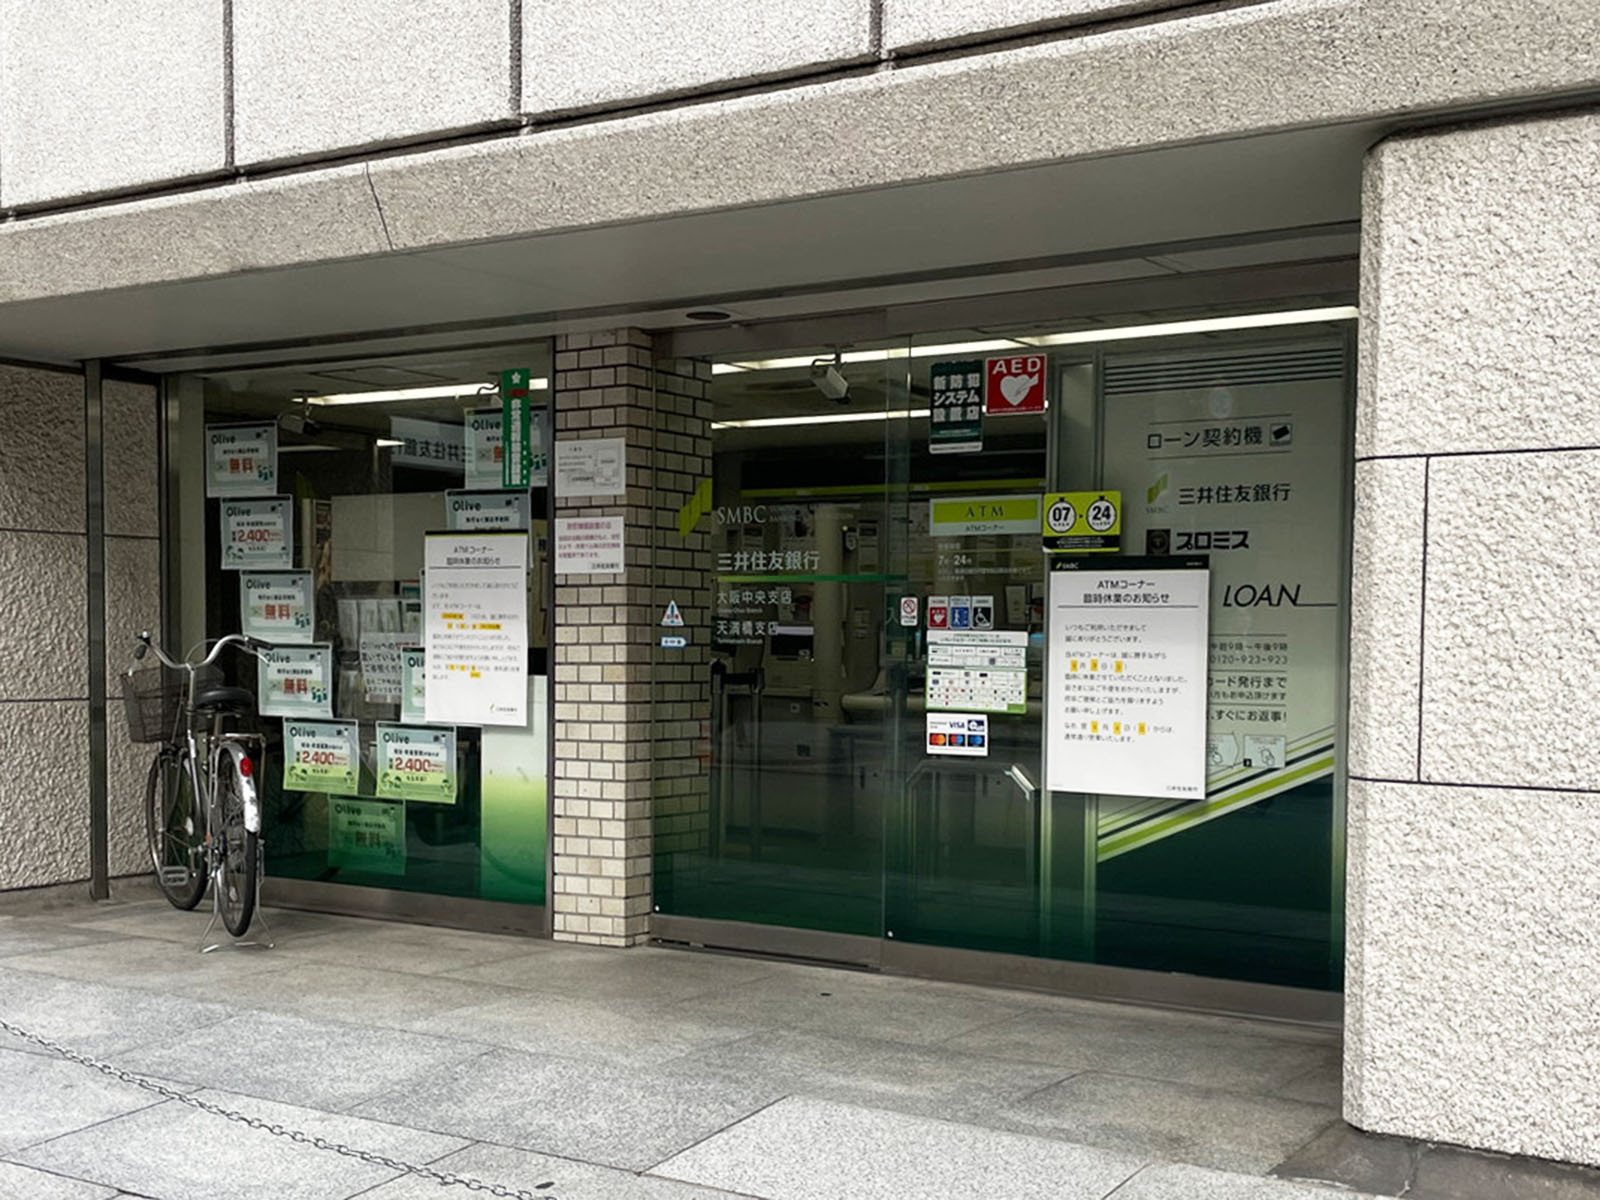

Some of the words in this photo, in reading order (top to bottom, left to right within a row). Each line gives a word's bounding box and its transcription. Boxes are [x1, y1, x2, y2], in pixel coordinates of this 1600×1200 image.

[992, 358, 1041, 375] AED
[933, 373, 981, 390] 新防犯
[933, 389, 980, 406] システム
[472, 420, 501, 431] Olive
[211, 434, 237, 446] Olive
[1147, 426, 1264, 450] ローン契約機
[1178, 483, 1291, 505] 三井住友銀行
[226, 506, 252, 519] Olive
[453, 500, 482, 512] Olive
[966, 505, 1004, 518] ATM
[717, 505, 767, 524] SMBC
[1053, 507, 1071, 522] 07
[1092, 505, 1111, 520] 24
[1176, 530, 1250, 552] プロミス
[717, 551, 821, 571] 三井住友銀行
[246, 579, 272, 590] Olive
[1096, 580, 1155, 591] ATMコーナー
[717, 590, 793, 605] 大阪中央支店
[1082, 593, 1170, 604] 臨時休業のお知らせ
[1222, 584, 1301, 607] LOAN
[265, 603, 292, 621] 無料
[408, 656, 425, 668] Oli
[284, 678, 310, 696] 無料
[949, 721, 965, 729] VISA
[290, 727, 317, 738] Olive
[383, 732, 410, 744] Olive
[335, 804, 362, 815] Olive
